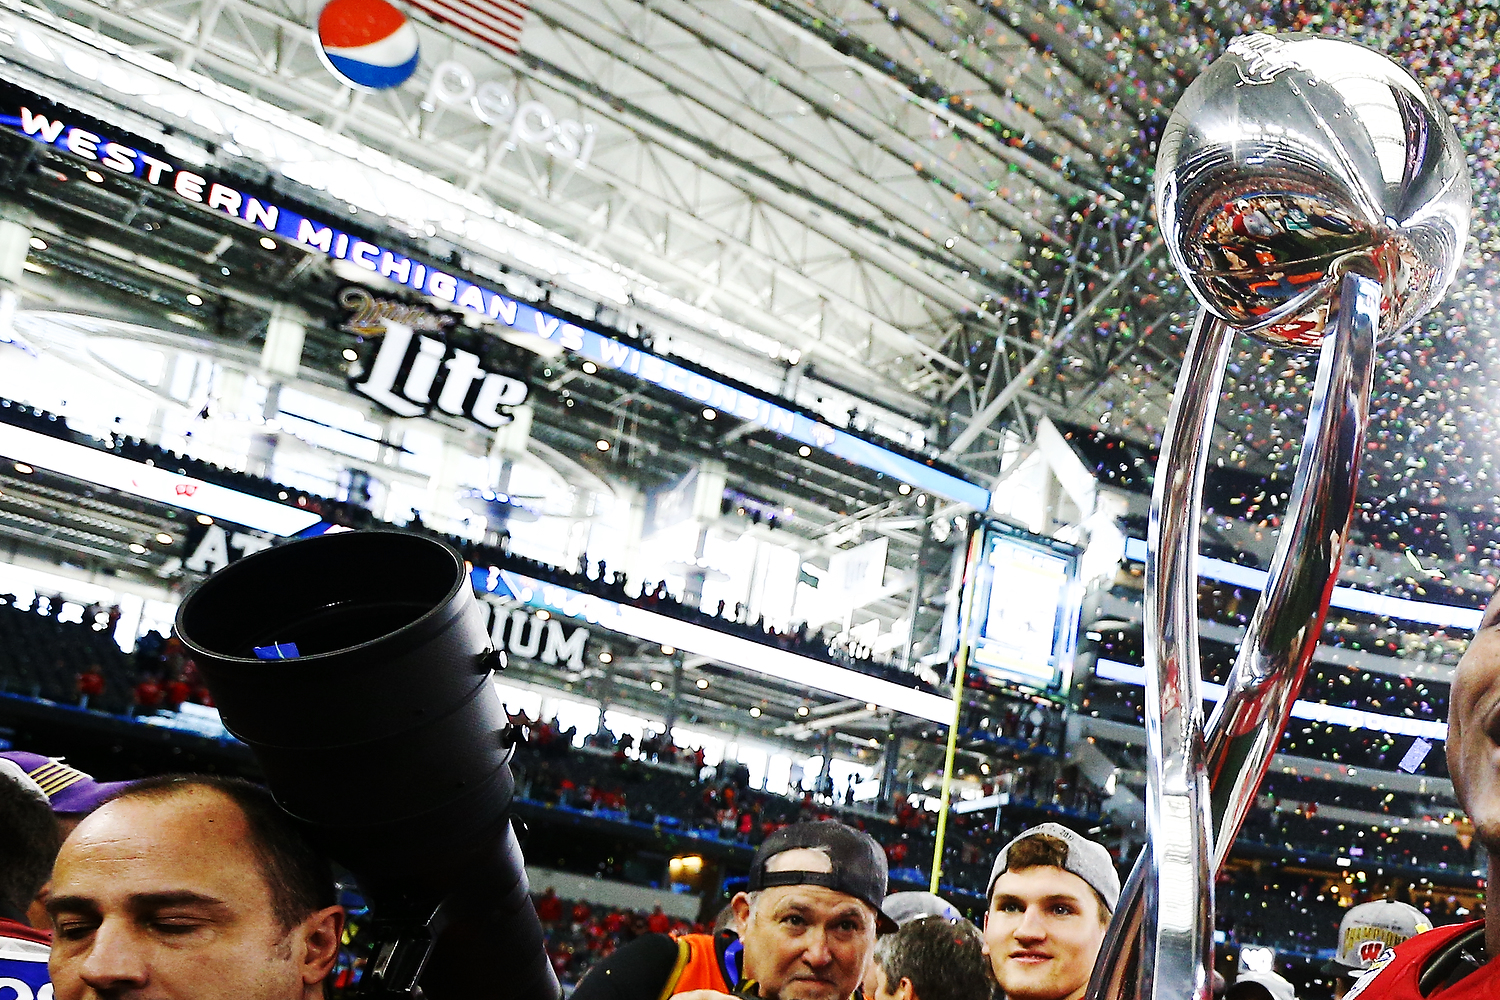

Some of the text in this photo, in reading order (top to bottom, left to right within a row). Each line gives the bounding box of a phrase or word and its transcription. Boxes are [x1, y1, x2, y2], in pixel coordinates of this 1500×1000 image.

[420, 60, 597, 170] pepsi
[20, 106, 796, 435] WESTERN MICHIGAN VS WISCONSIN
[356, 317, 529, 429] Lite
[479, 600, 591, 672] IUM
